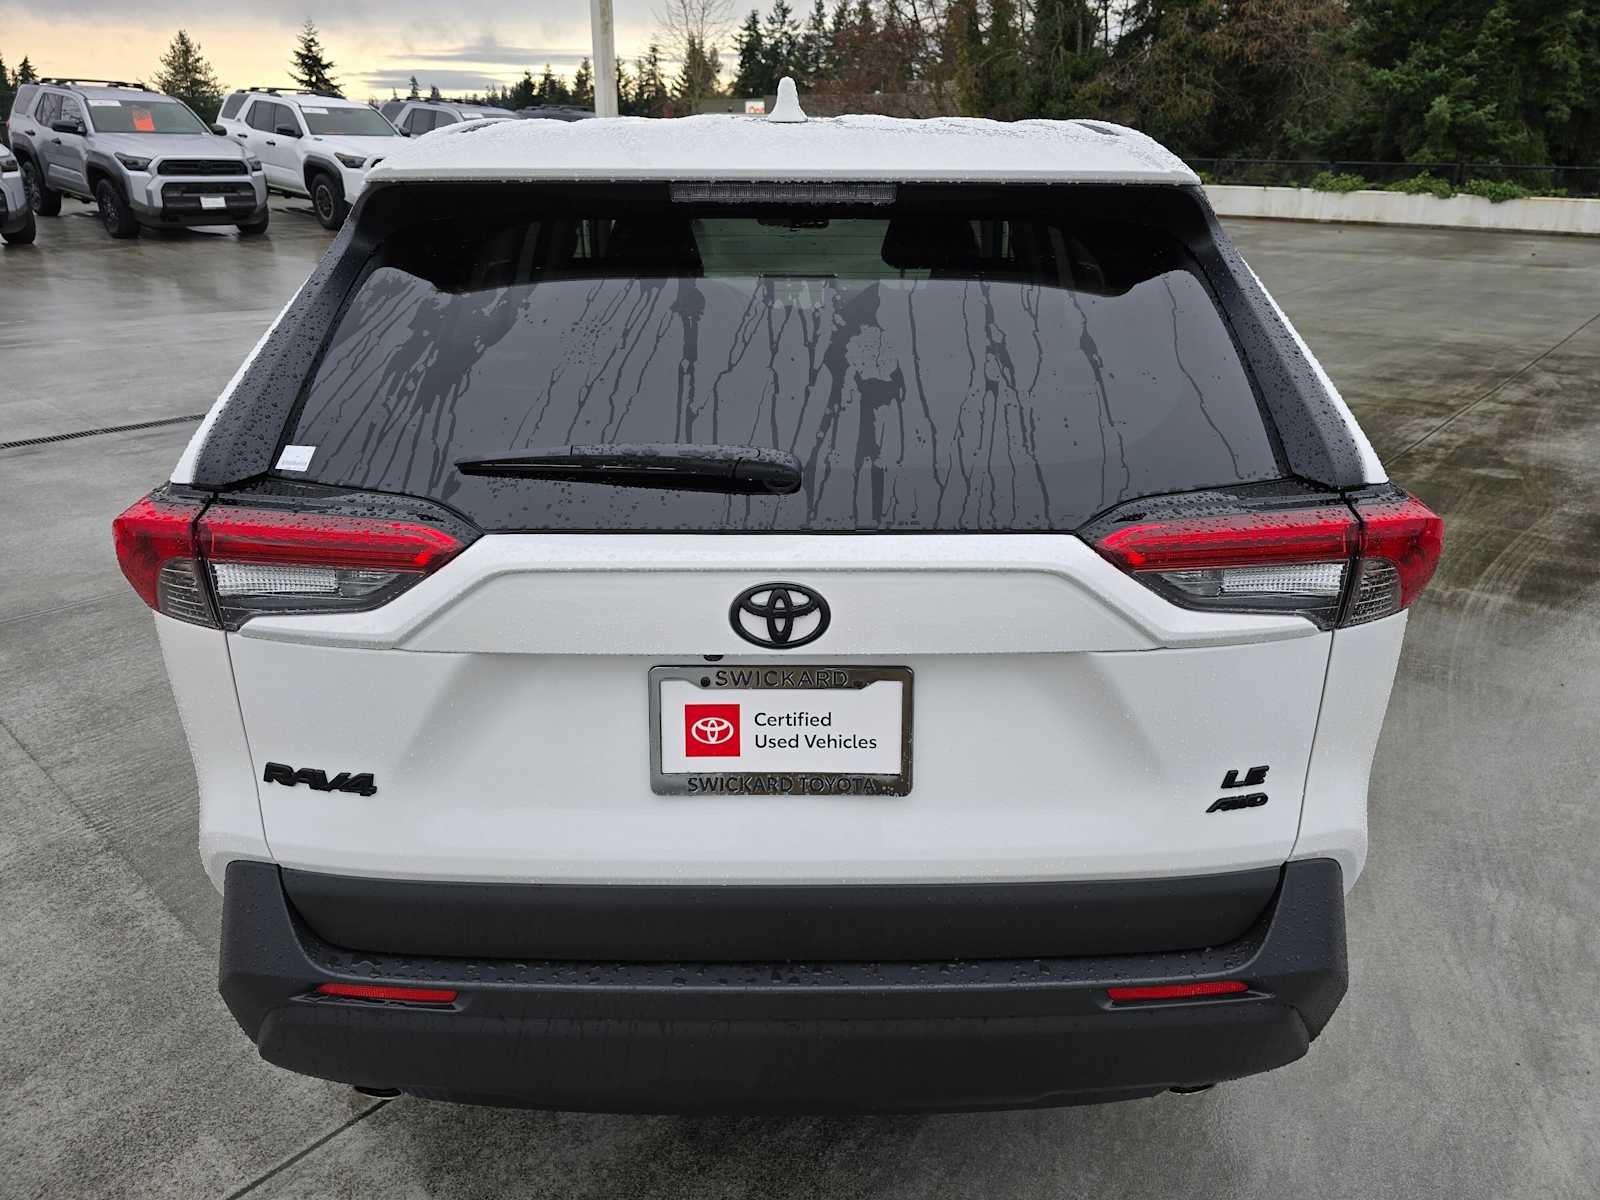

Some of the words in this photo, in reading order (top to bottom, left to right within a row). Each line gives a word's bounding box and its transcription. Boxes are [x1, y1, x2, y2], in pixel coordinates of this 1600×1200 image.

[714, 669, 849, 688] SWICKARD
[753, 711, 832, 727] Certified
[754, 733, 799, 749] Used
[804, 733, 877, 749] Vehicles
[263, 761, 378, 797] RAV4
[687, 776, 794, 794] SWICKARD
[799, 776, 877, 793] TOYOTA
[1220, 765, 1270, 789] LE
[1205, 791, 1269, 813] AWD
